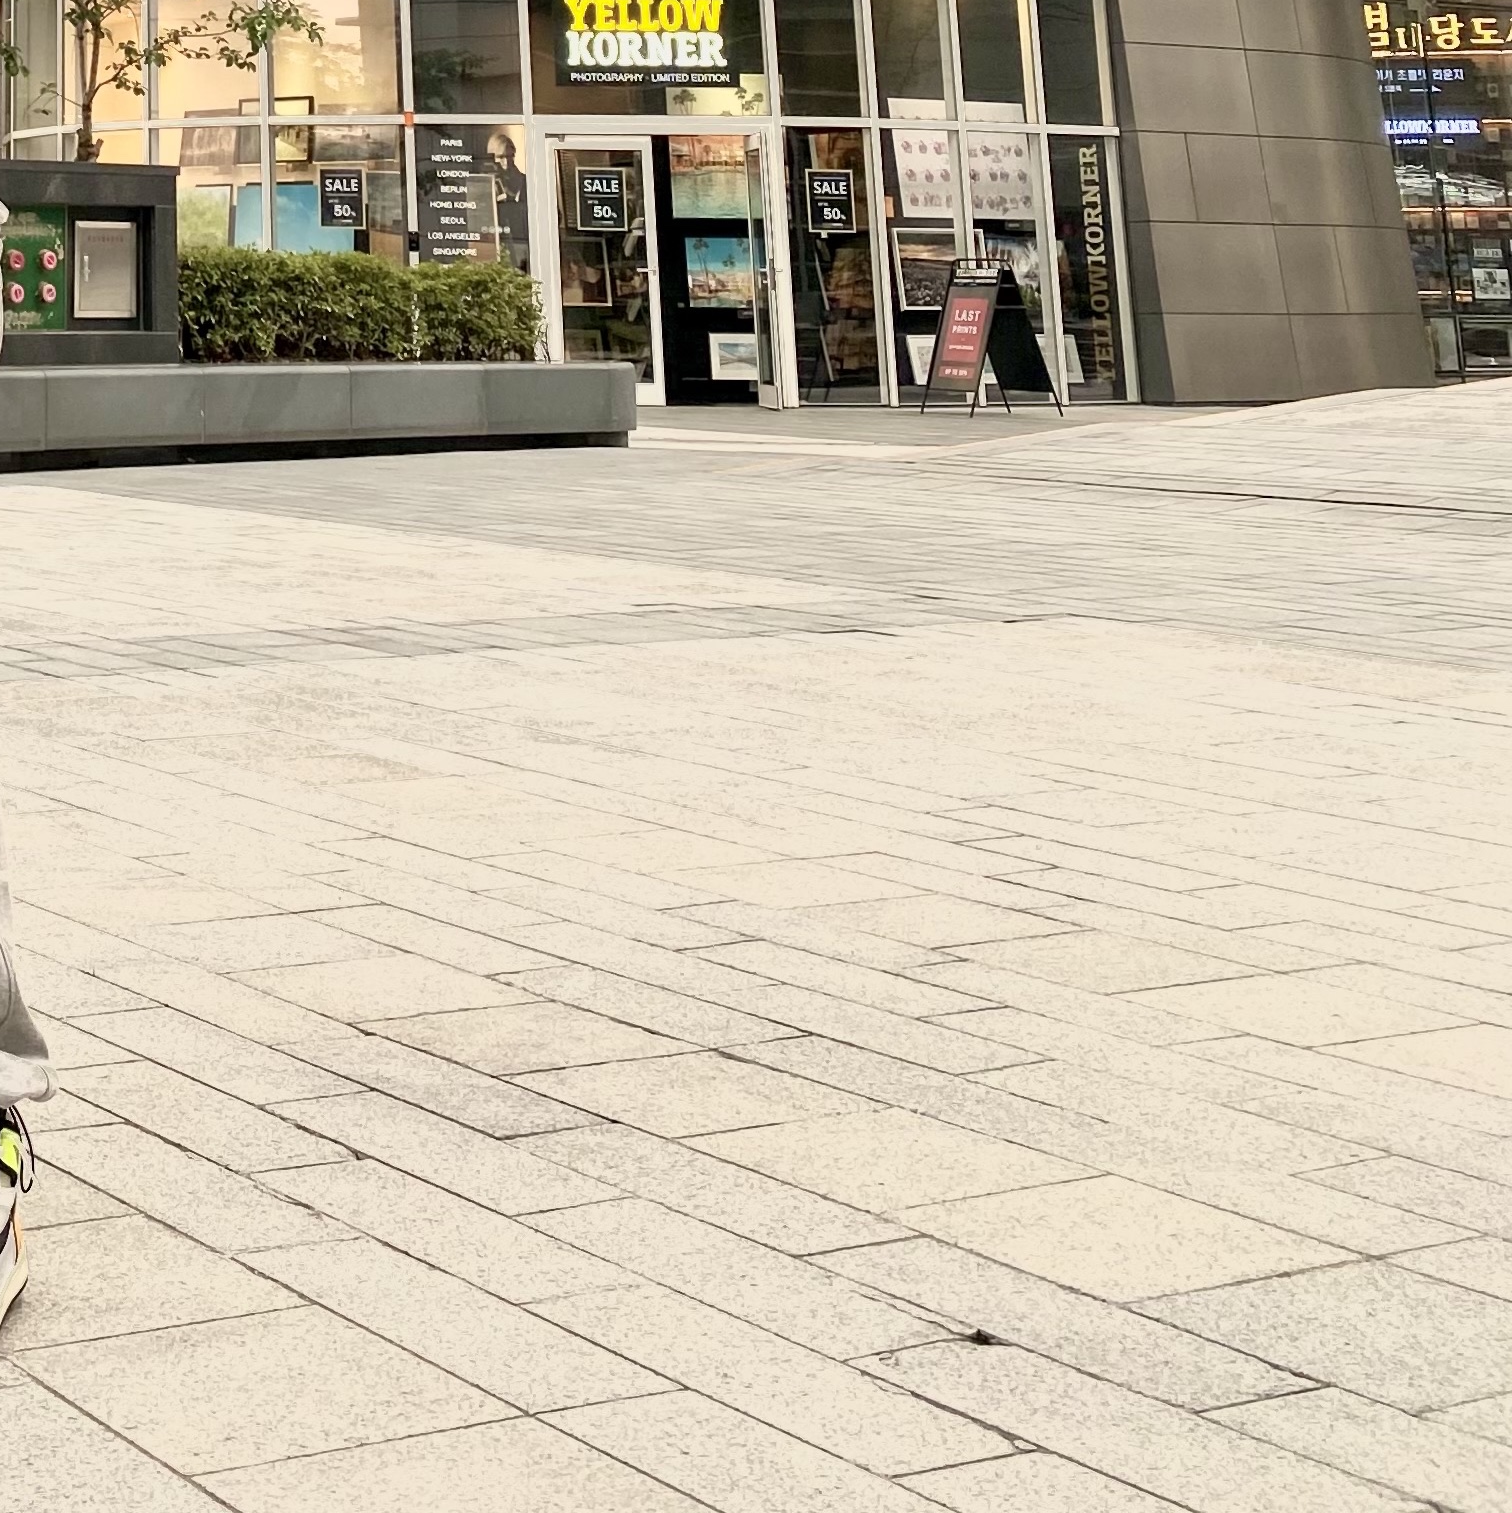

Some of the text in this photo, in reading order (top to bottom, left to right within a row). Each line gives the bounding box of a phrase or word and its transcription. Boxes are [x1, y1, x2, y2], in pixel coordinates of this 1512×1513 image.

[565, 30, 728, 67] KORNER
[570, 72, 730, 83] PHOTOGRAPHY LIMITED EDITION
[440, 139, 463, 147] PARIS
[436, 169, 469, 178] LONDON
[324, 178, 359, 192] SALE
[440, 185, 468, 194] BERLIN
[583, 179, 619, 193] SALE
[813, 181, 847, 195] SALE
[429, 200, 477, 209] HONG KONG
[440, 216, 467, 225] SEOUL
[427, 231, 481, 241] LOS ANGELES
[432, 247, 478, 256] SINGAPORE
[954, 309, 982, 322] LAST
